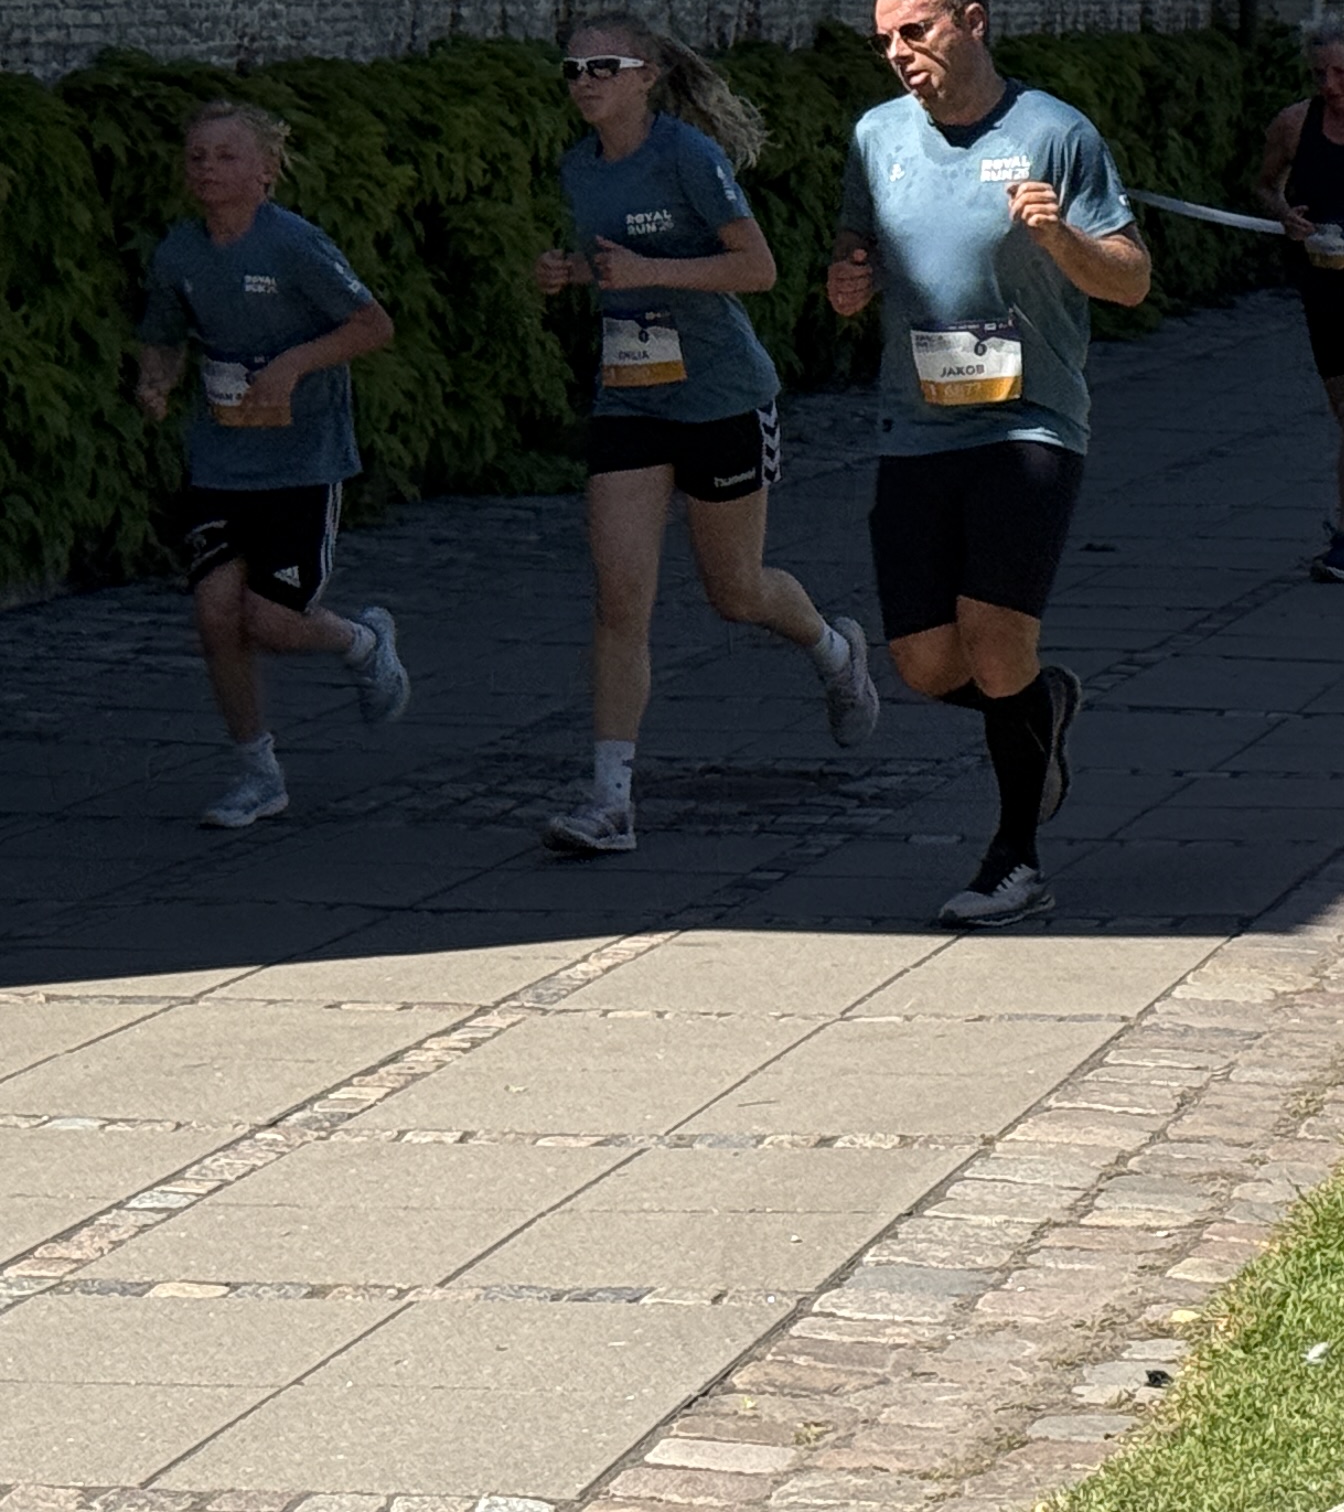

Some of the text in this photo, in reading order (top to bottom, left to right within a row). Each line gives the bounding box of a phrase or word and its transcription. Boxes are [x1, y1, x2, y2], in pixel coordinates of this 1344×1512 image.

[981, 155, 1030, 169] ROYAL
[626, 209, 671, 224] ROYAL
[940, 364, 985, 378] JAKOB
[713, 466, 756, 489] hummel
